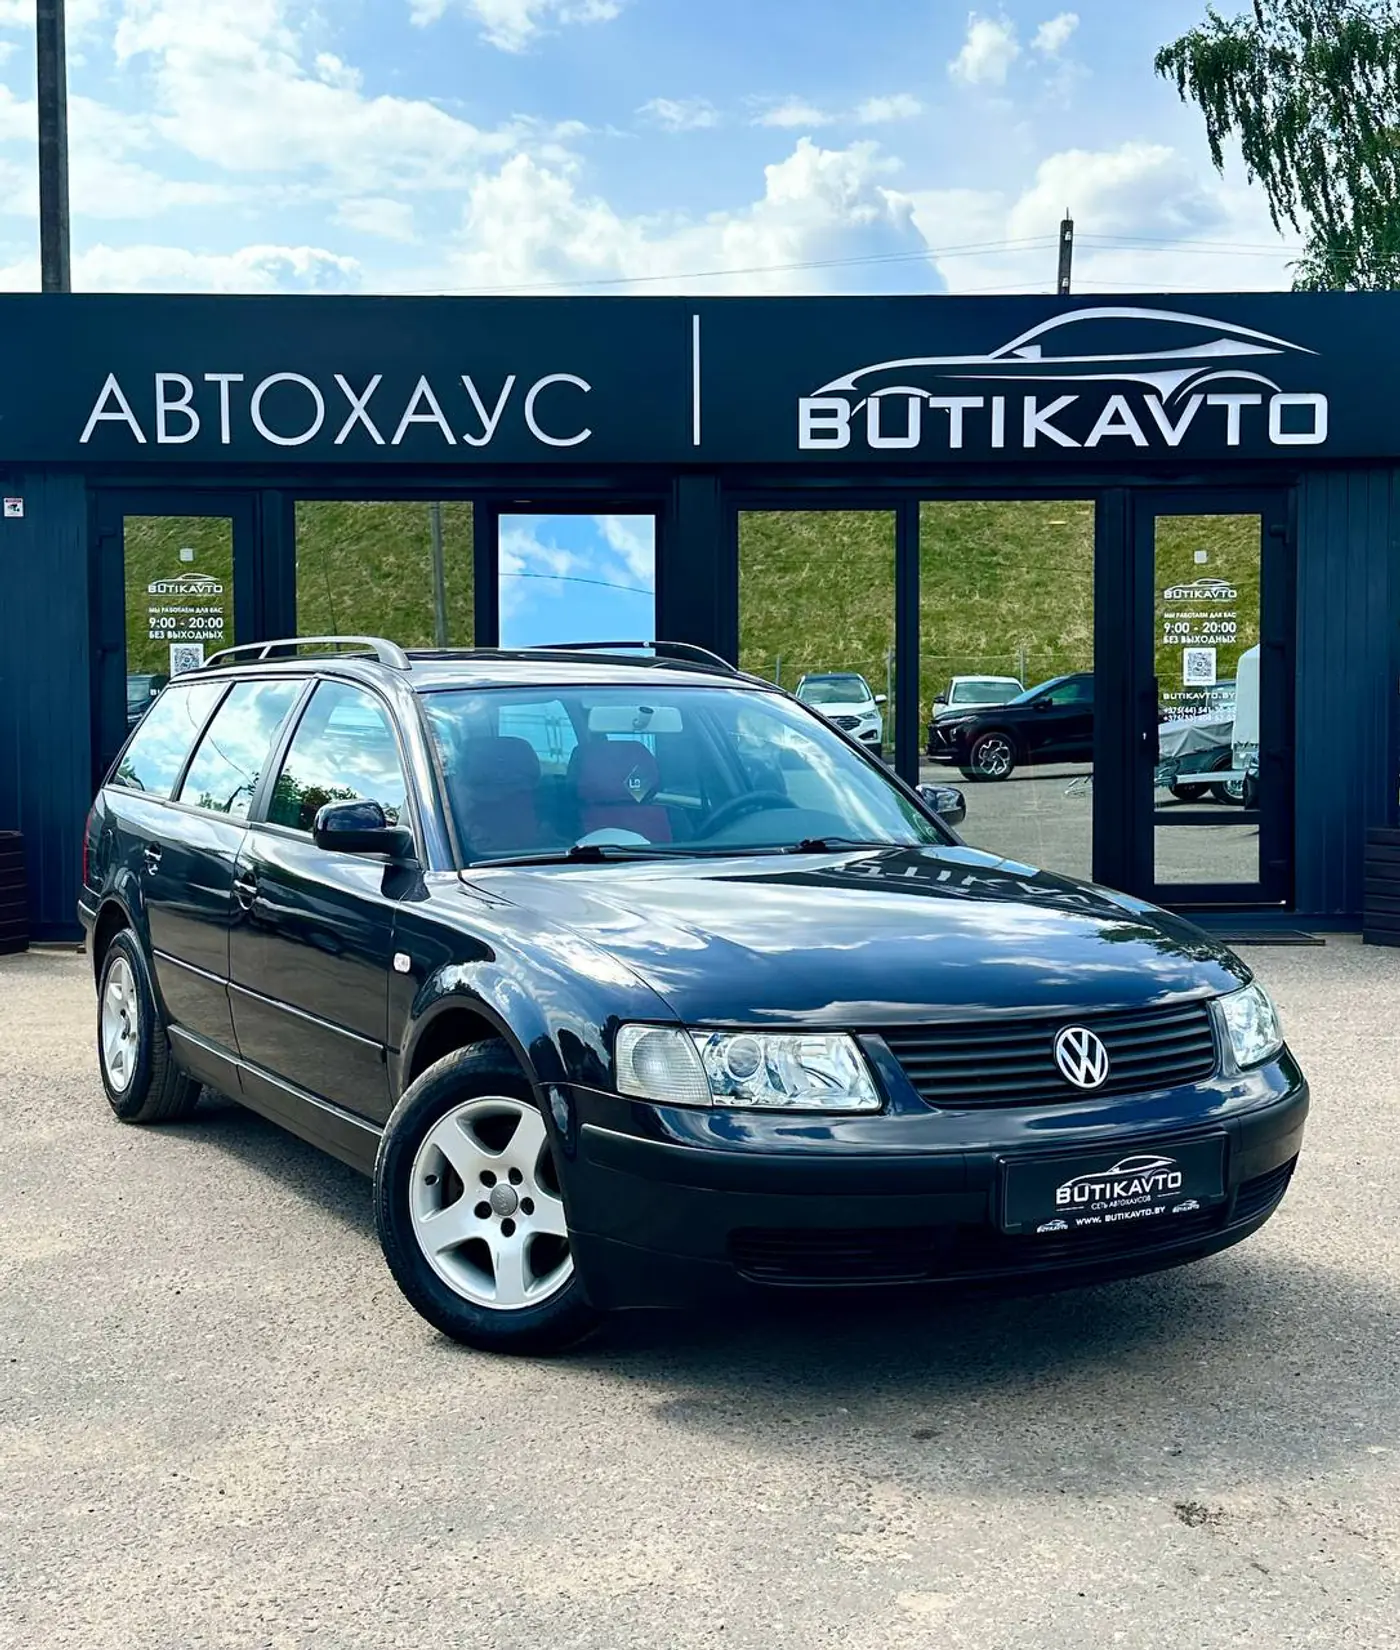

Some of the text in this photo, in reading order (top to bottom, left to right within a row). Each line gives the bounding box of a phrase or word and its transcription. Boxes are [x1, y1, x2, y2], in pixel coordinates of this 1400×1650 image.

[79, 372, 592, 447] АВТОХАУС
[798, 393, 1328, 450] BUTIKAVTO
[148, 584, 223, 593] BUTIKAVTO
[1164, 590, 1238, 599] BUTIKAVTO
[149, 617, 176, 629] 9:00
[189, 617, 224, 629] 20:00
[1164, 622, 1190, 633] 9:00
[1202, 622, 1237, 633] 20:00
[149, 630, 224, 640] БЕЗ ВЫХОДНЫХ
[1163, 635, 1236, 645] БЕЗ ВЫХОДНЫХ
[1163, 692, 1235, 700] BUTIKAVTO.BY
[1056, 1027, 1109, 1089] VW
[1056, 1172, 1182, 1204] BUTIKAVTO
[1104, 1206, 1166, 1222] BUTIKAVTO.BY
